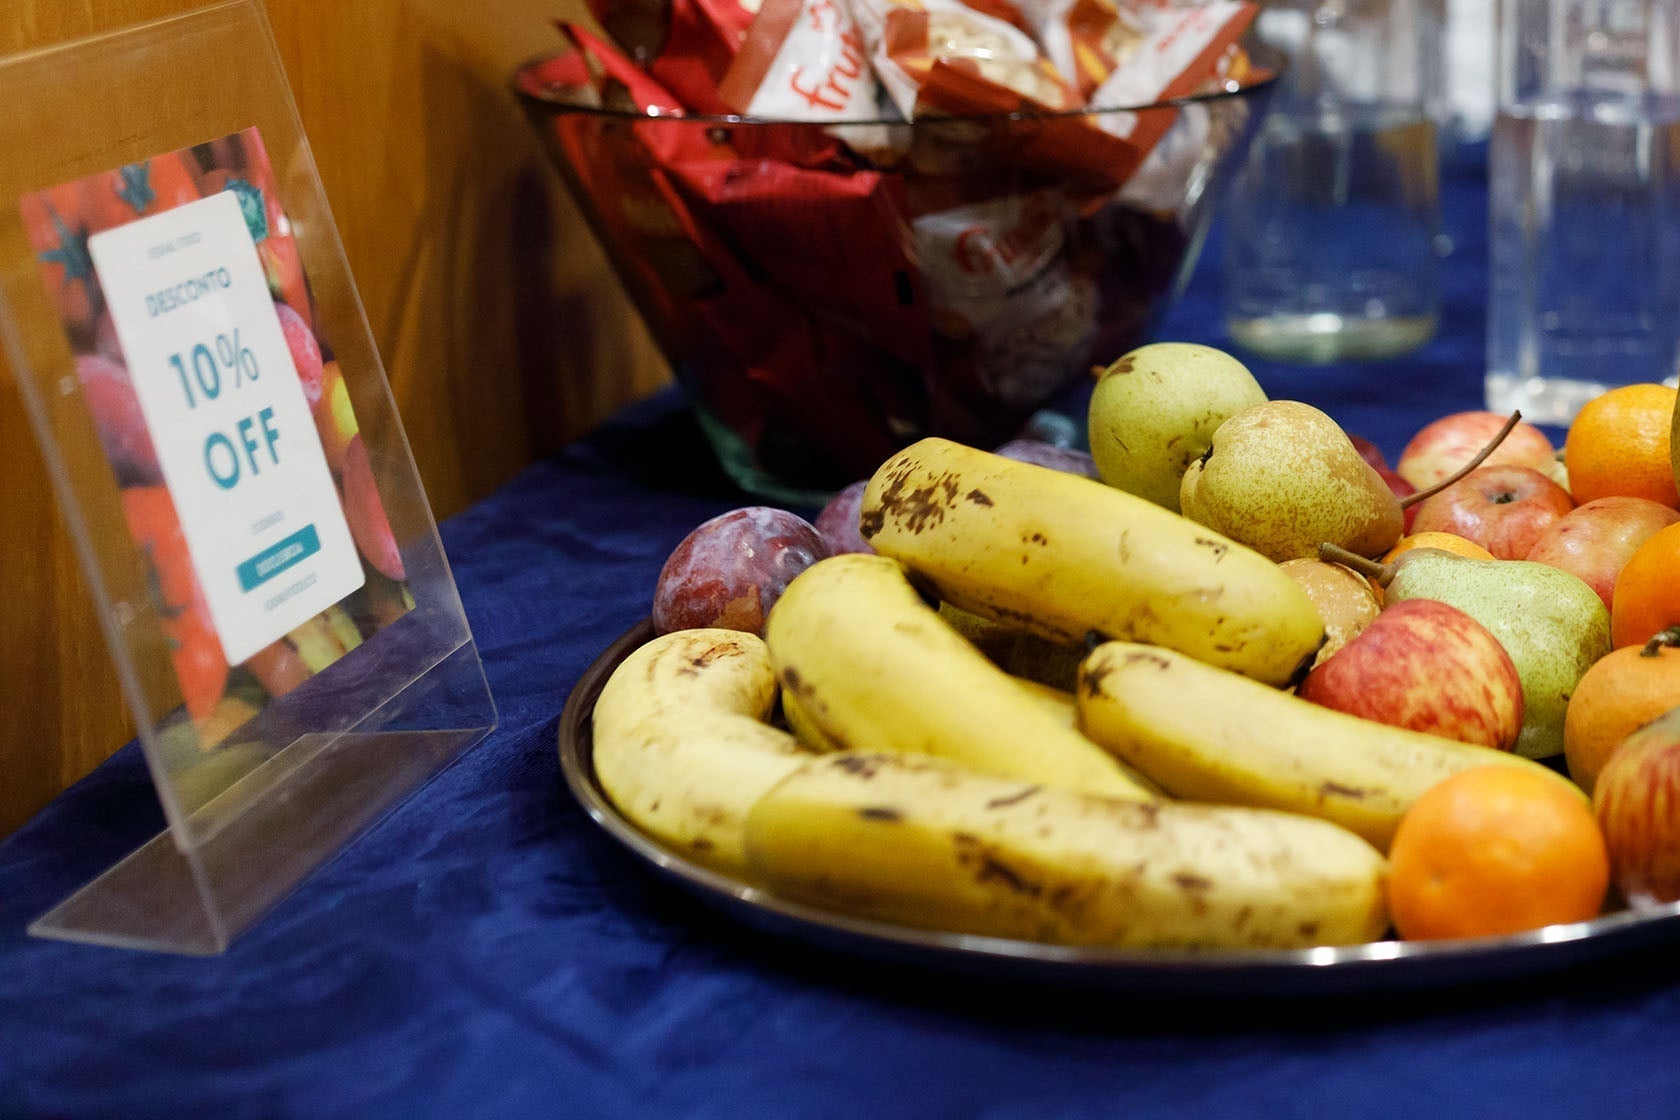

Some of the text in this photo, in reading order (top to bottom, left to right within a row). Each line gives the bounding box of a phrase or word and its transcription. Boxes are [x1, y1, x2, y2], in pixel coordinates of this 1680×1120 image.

[145, 267, 231, 317] DESCONTO
[168, 328, 259, 409] 10%
[204, 407, 279, 490] OFF
